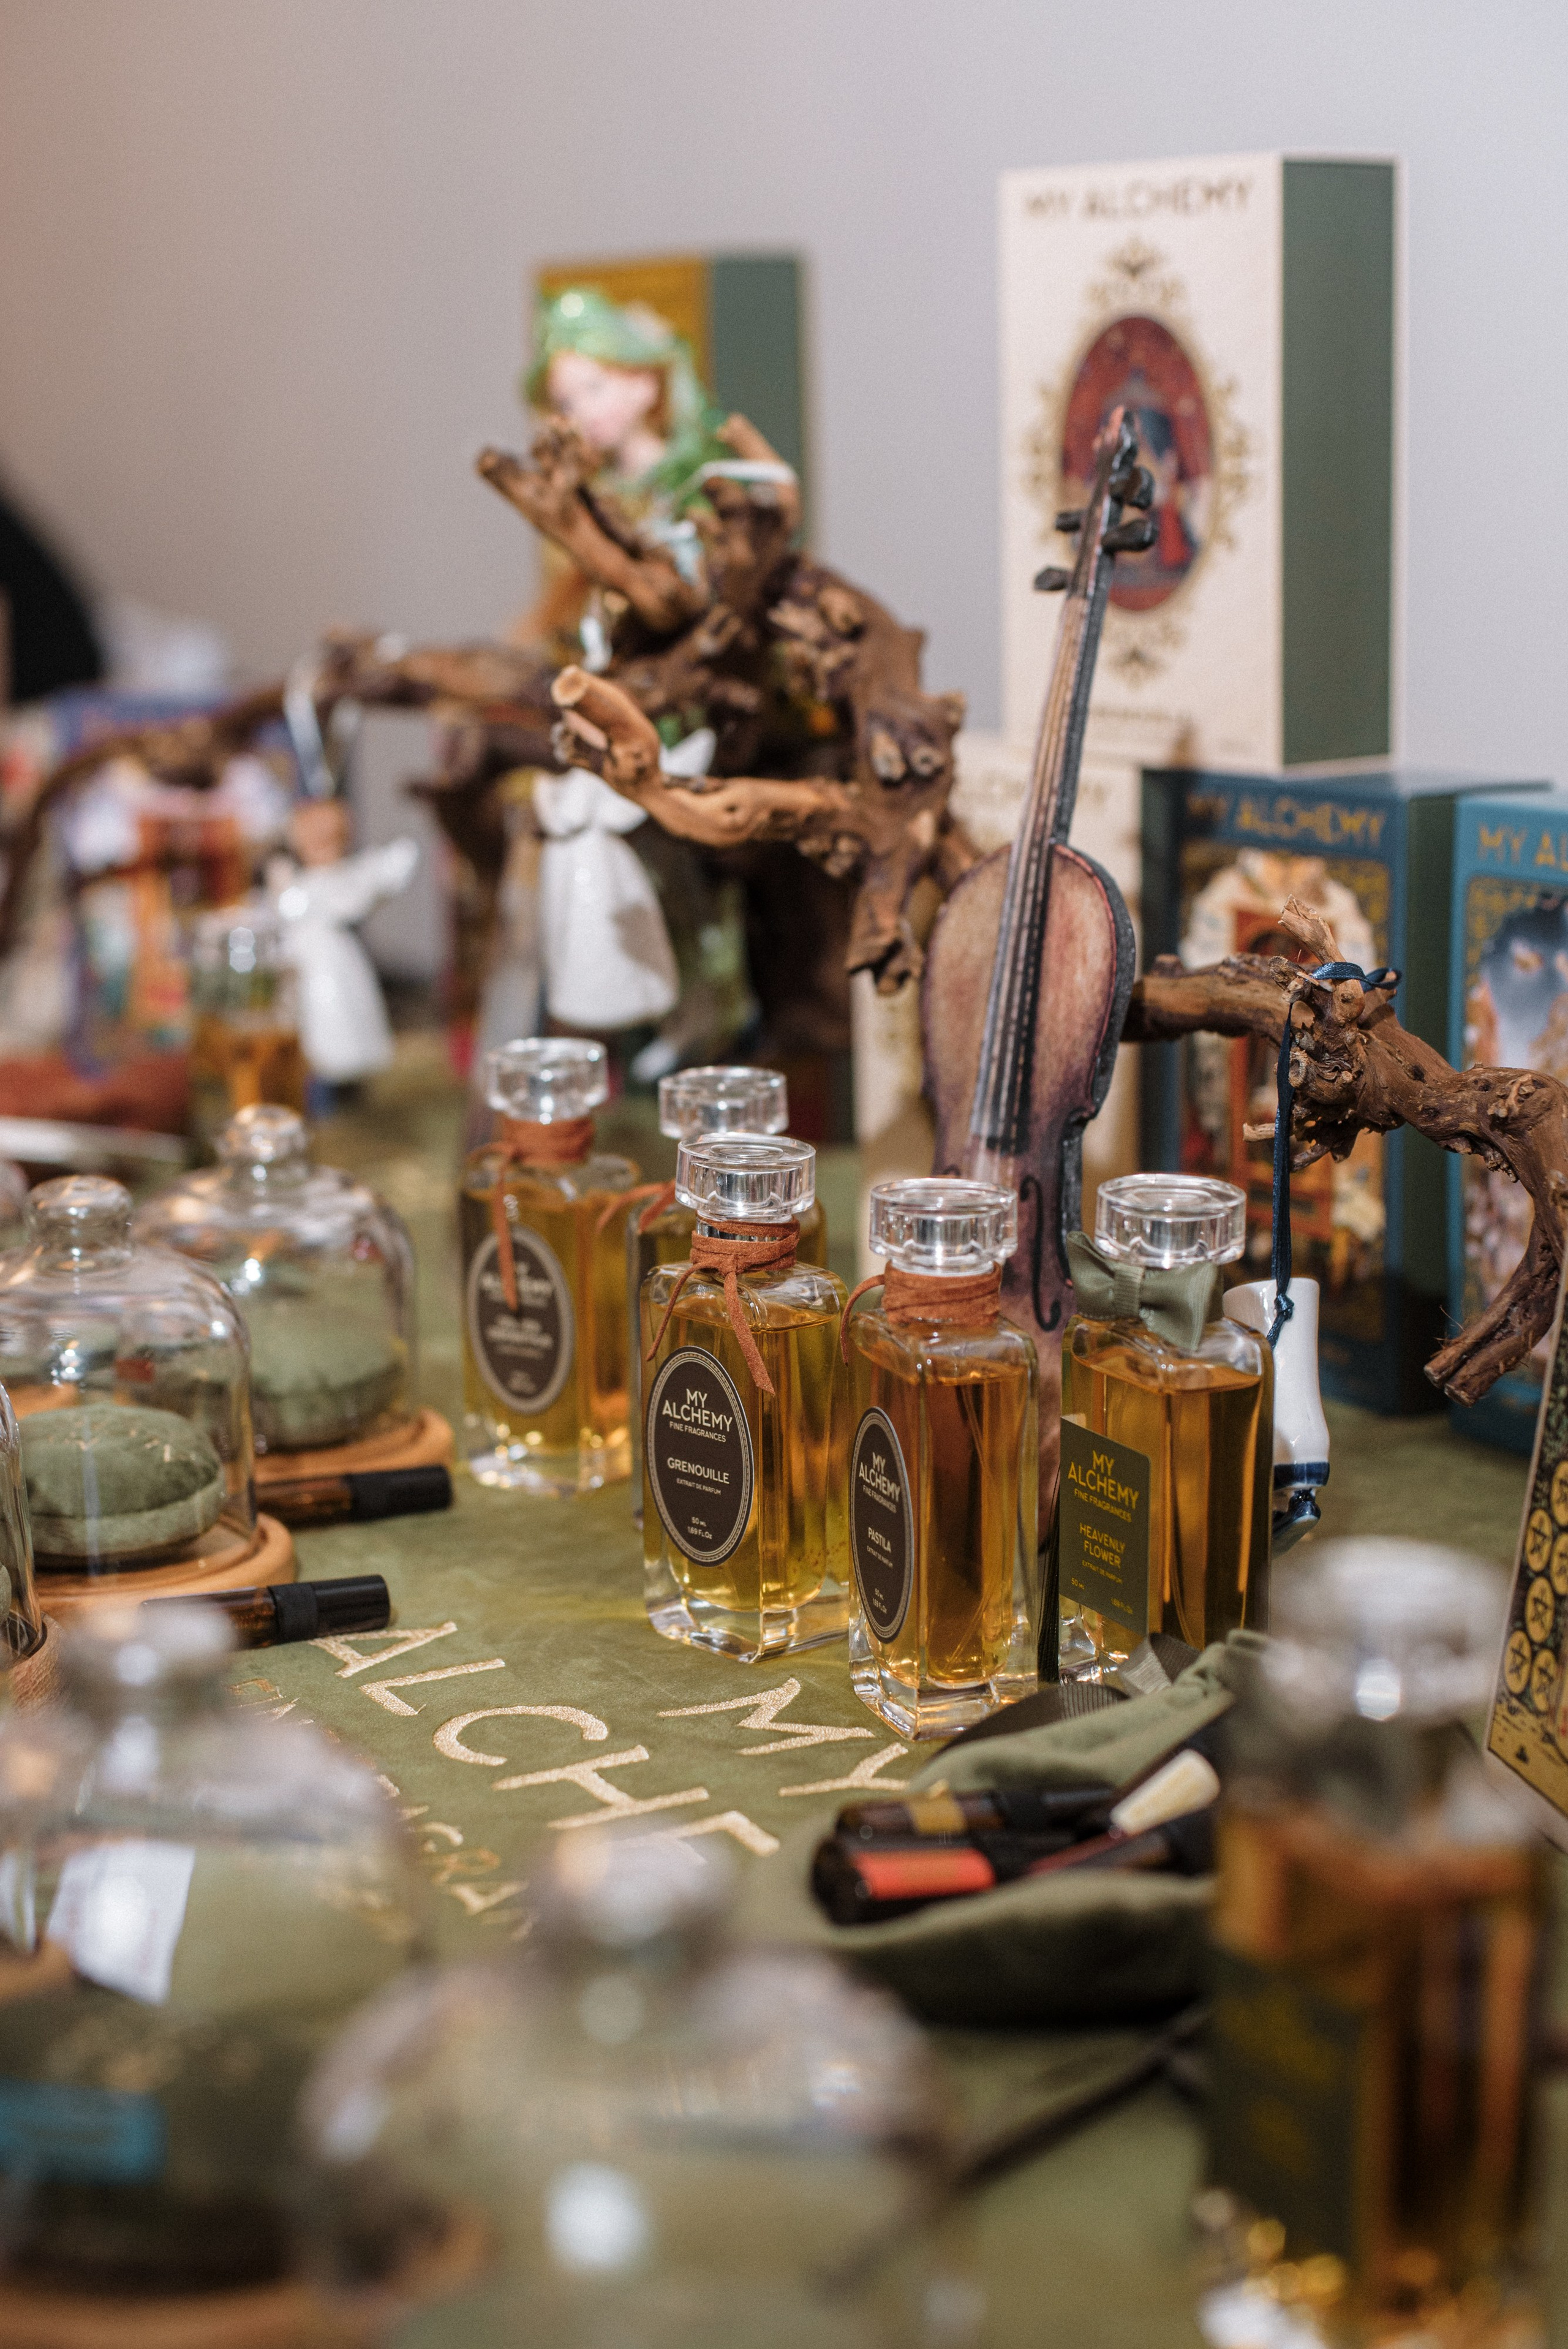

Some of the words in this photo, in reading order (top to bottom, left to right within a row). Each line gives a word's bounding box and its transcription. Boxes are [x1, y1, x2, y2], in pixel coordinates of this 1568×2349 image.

[1235, 796, 1388, 848] ALCHEMY
[1477, 822, 1529, 864] MY
[686, 1388, 707, 1408] MY
[662, 1400, 733, 1432] ALCHEMY
[669, 1421, 684, 1431] FINE
[684, 1425, 726, 1442] FRAGRANCES
[667, 1457, 730, 1485] GRENOUILLE
[872, 1451, 886, 1475] MY
[1092, 1450, 1115, 1477] MY
[676, 1477, 695, 1488] EXTRAIT
[703, 1485, 722, 1495] PARFUM
[859, 1461, 901, 1503] ALCHEMY
[1068, 1461, 1139, 1510] ALCHEMY
[1074, 1488, 1088, 1503] FINE
[868, 1526, 892, 1553] PASTILA
[1080, 1522, 1126, 1554] HEAVENLY
[1084, 1540, 1121, 1570] FLOWER
[1071, 1577, 1079, 1586] 50
